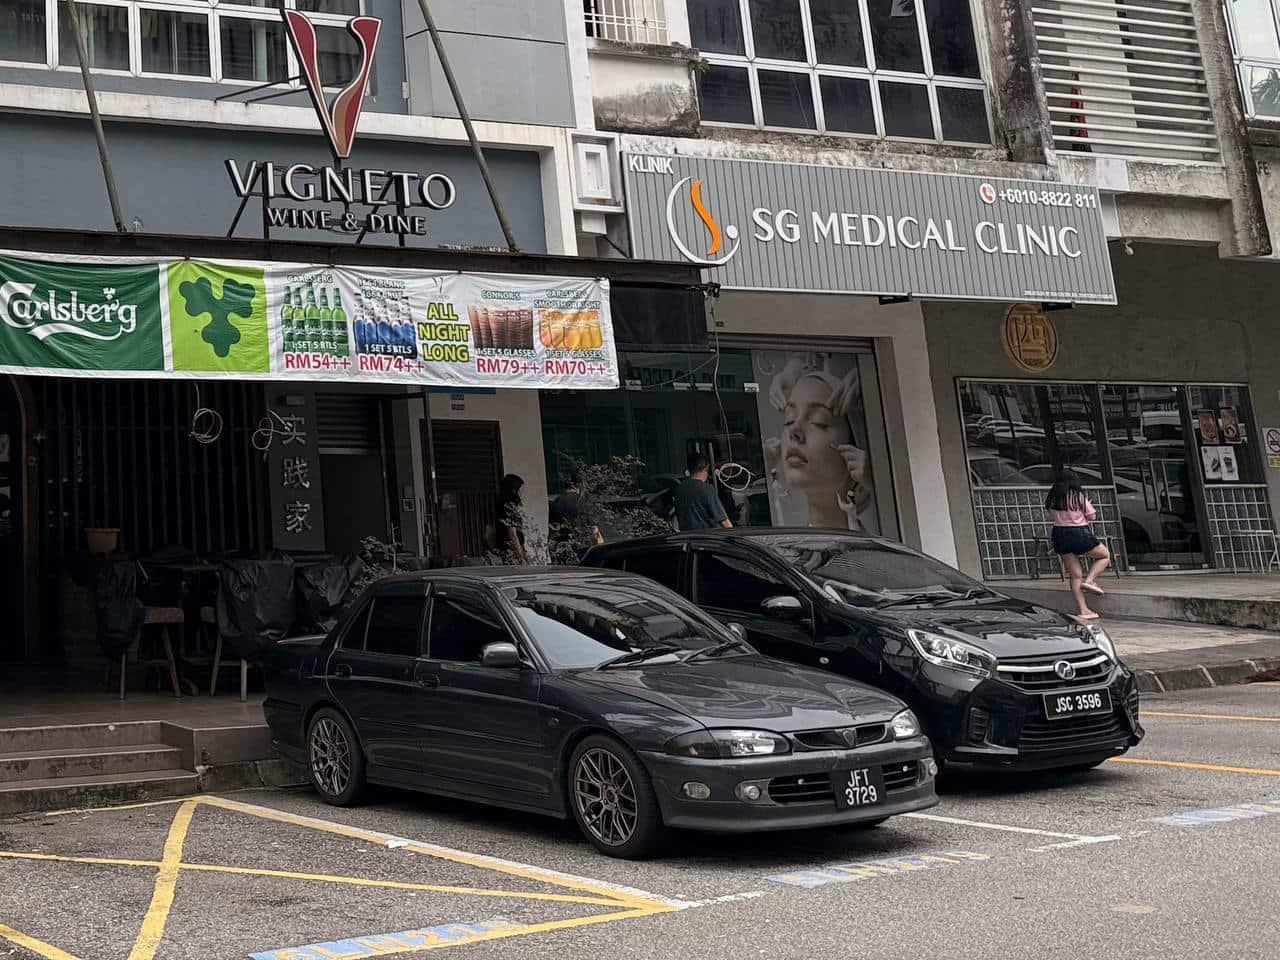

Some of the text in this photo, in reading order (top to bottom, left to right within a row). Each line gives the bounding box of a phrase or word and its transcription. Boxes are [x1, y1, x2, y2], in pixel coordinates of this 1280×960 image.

[628, 154, 674, 175] KLINIK
[224, 159, 457, 210] VIGNETO
[1074, 192, 1098, 209] 811
[267, 207, 426, 235] WINE & DINE
[752, 206, 1083, 259] SG MEDICAL CLINIC
[427, 302, 458, 321] ALL
[417, 322, 470, 341] NIGHT
[297, 341, 312, 350] SET
[371, 345, 385, 353] SET
[423, 344, 469, 362] LONG
[482, 348, 496, 357] SET
[503, 349, 537, 358] GLASSES
[571, 350, 602, 359] GLASSES
[285, 354, 351, 370] RM54++
[359, 355, 425, 372] RM74++
[476, 358, 539, 374] RM79++
[545, 360, 605, 375] RM70++
[1055, 692, 1102, 714] JSC 3596
[847, 768, 869, 788] JFT
[845, 785, 878, 806] 3729
